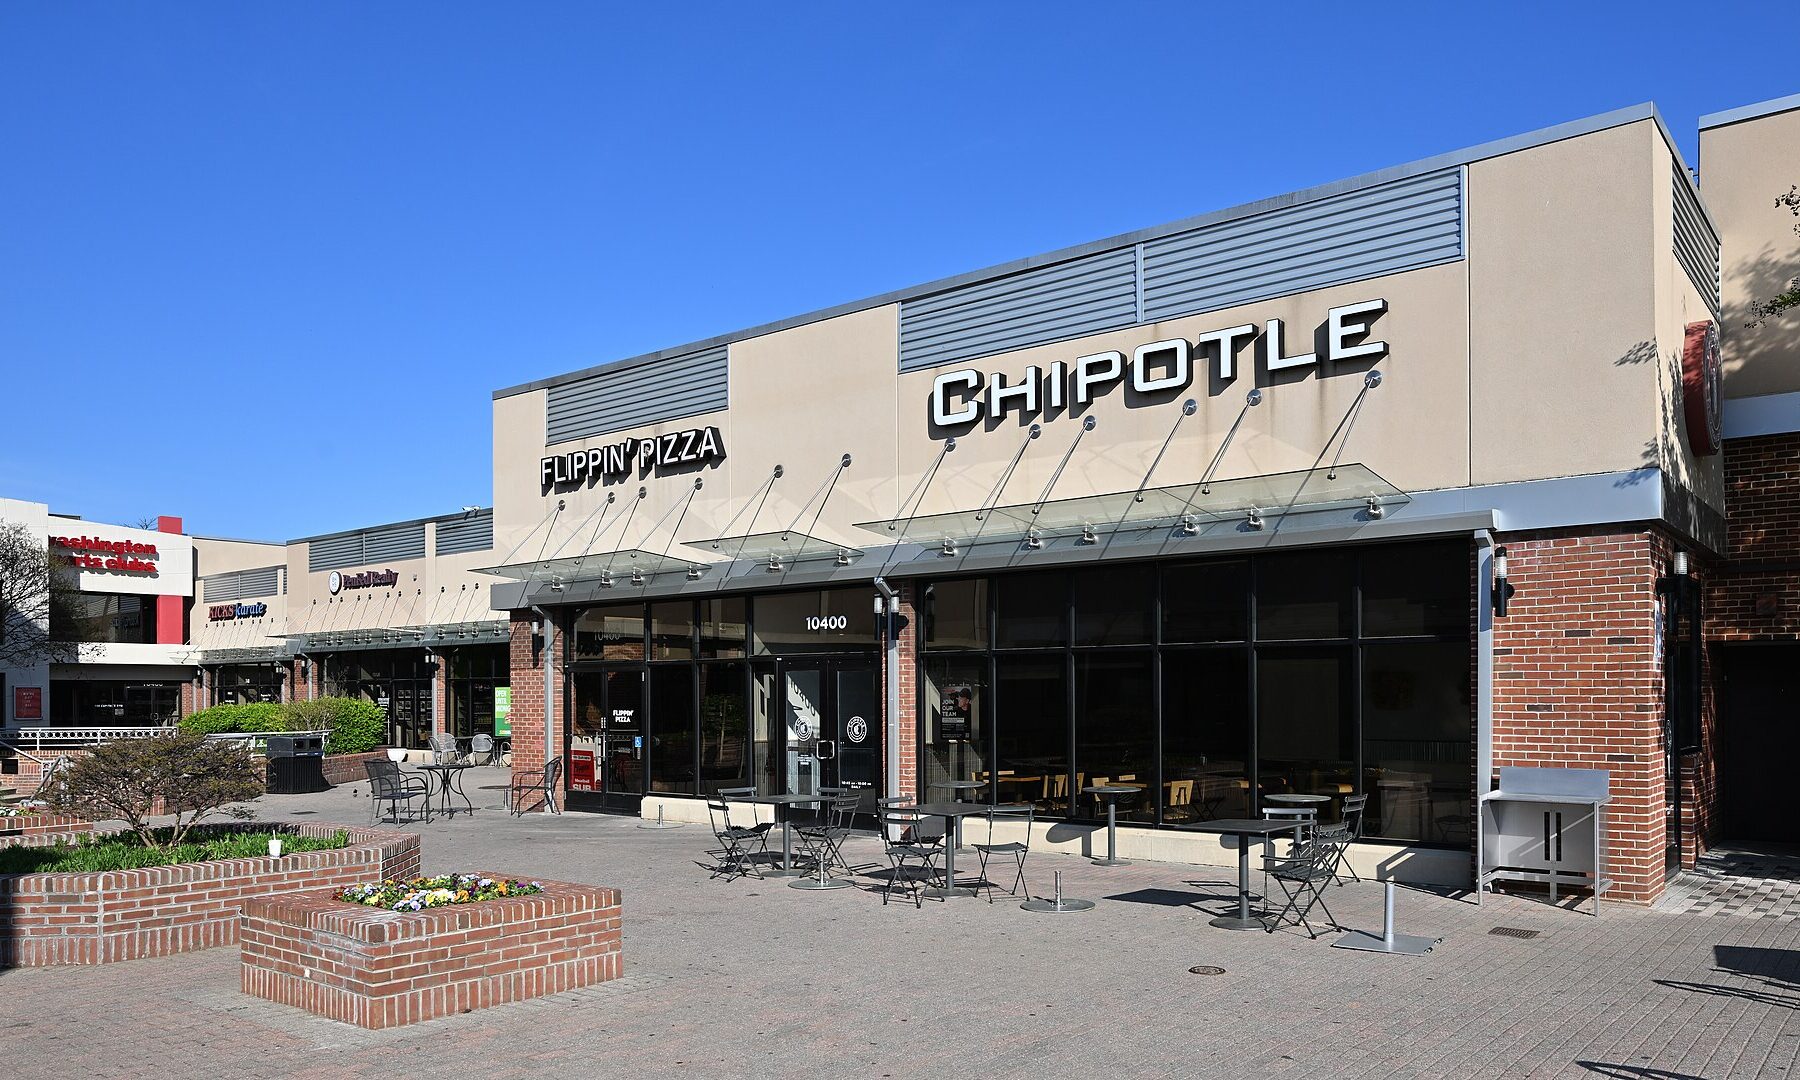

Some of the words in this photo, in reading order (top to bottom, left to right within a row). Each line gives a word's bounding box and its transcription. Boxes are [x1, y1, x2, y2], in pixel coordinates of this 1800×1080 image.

[932, 298, 1387, 426] CHIPOTLE
[541, 438, 634, 485] FLIPPIN'
[639, 427, 720, 468] PIZZA
[105, 556, 157, 573] clubs
[372, 569, 399, 589] Realty
[208, 604, 235, 619] KICKS
[236, 602, 265, 616] karate
[806, 615, 847, 630] 10400
